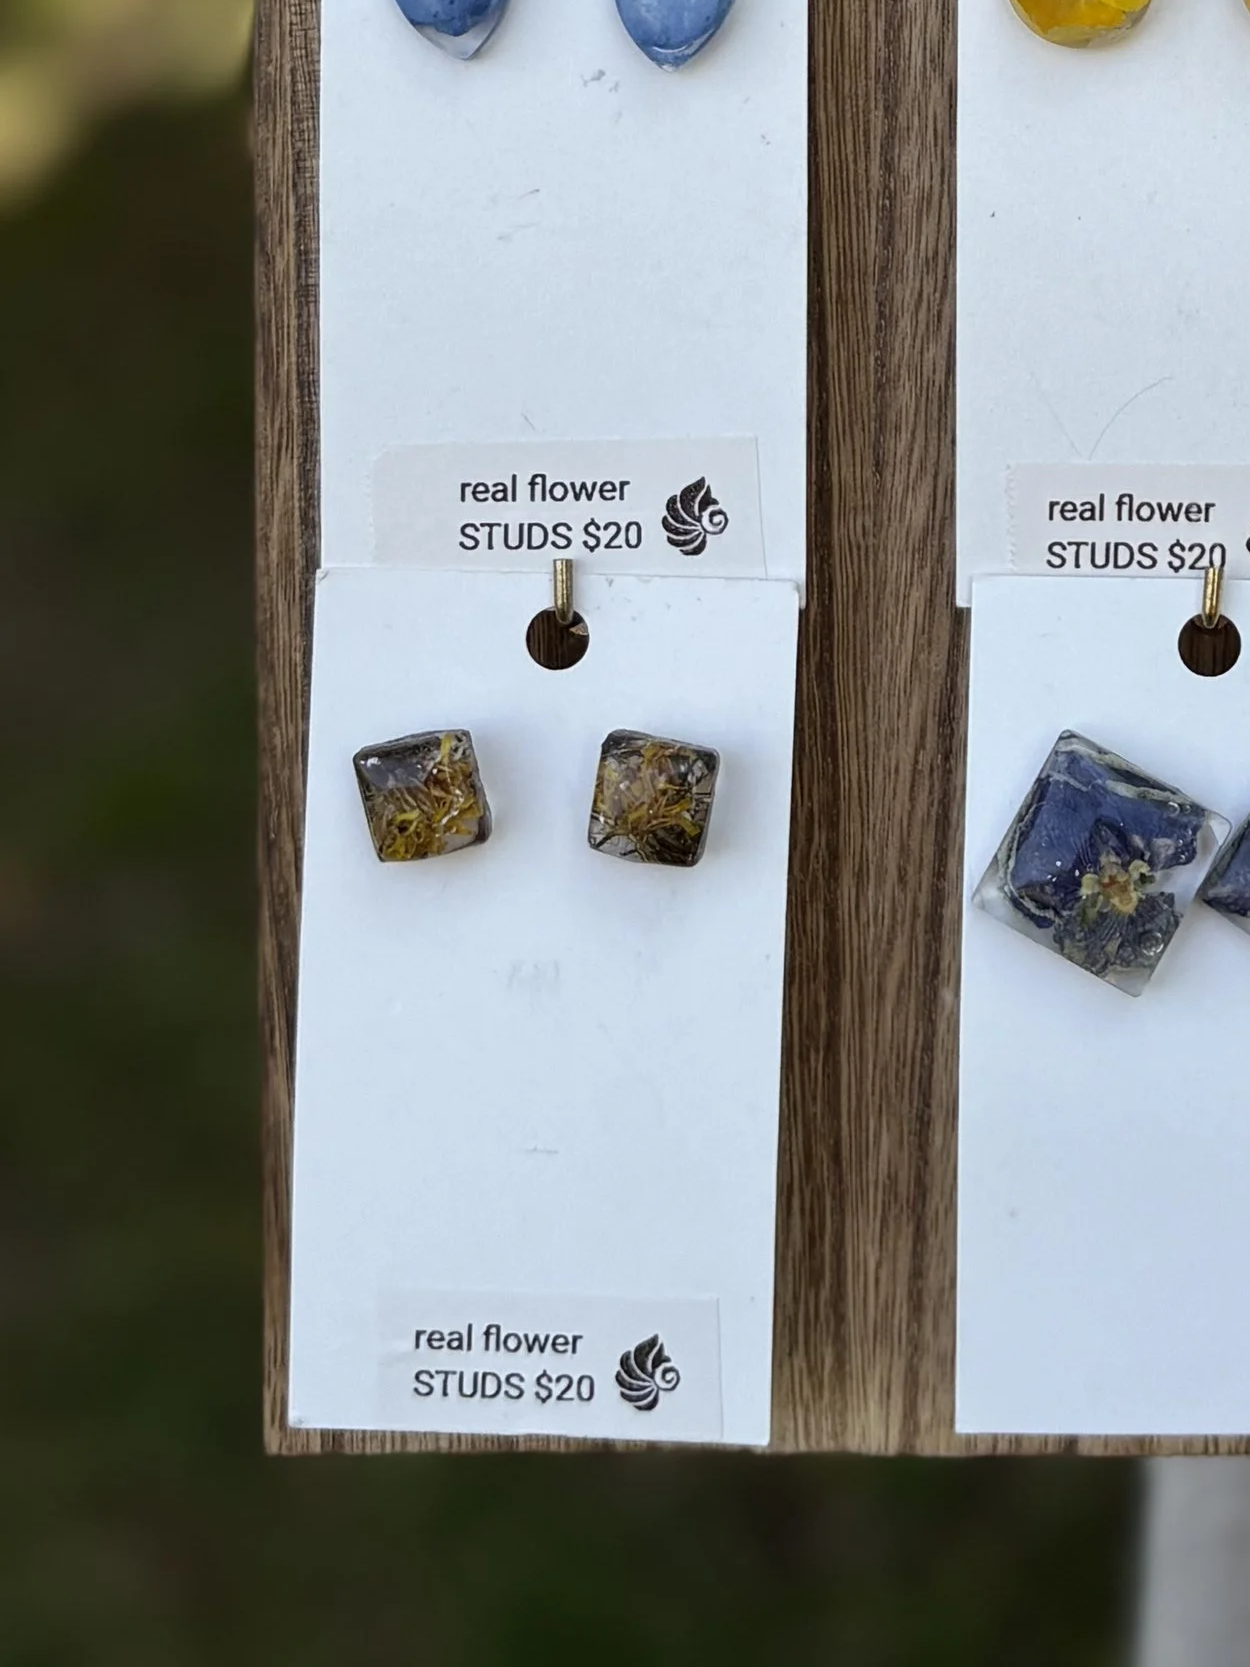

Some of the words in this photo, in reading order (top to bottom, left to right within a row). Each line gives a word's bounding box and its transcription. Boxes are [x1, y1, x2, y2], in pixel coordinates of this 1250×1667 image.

[460, 474, 517, 503] real
[528, 474, 631, 502] flower
[1048, 493, 1105, 522] real
[1116, 493, 1216, 523] flower
[459, 521, 573, 551] STUDS
[582, 518, 642, 553] $20
[1046, 540, 1159, 570] STUDS
[1167, 539, 1227, 573] $20
[414, 1323, 473, 1352] real
[483, 1323, 584, 1355] flower
[413, 1369, 526, 1401] STUDS
[535, 1370, 595, 1404] $20
